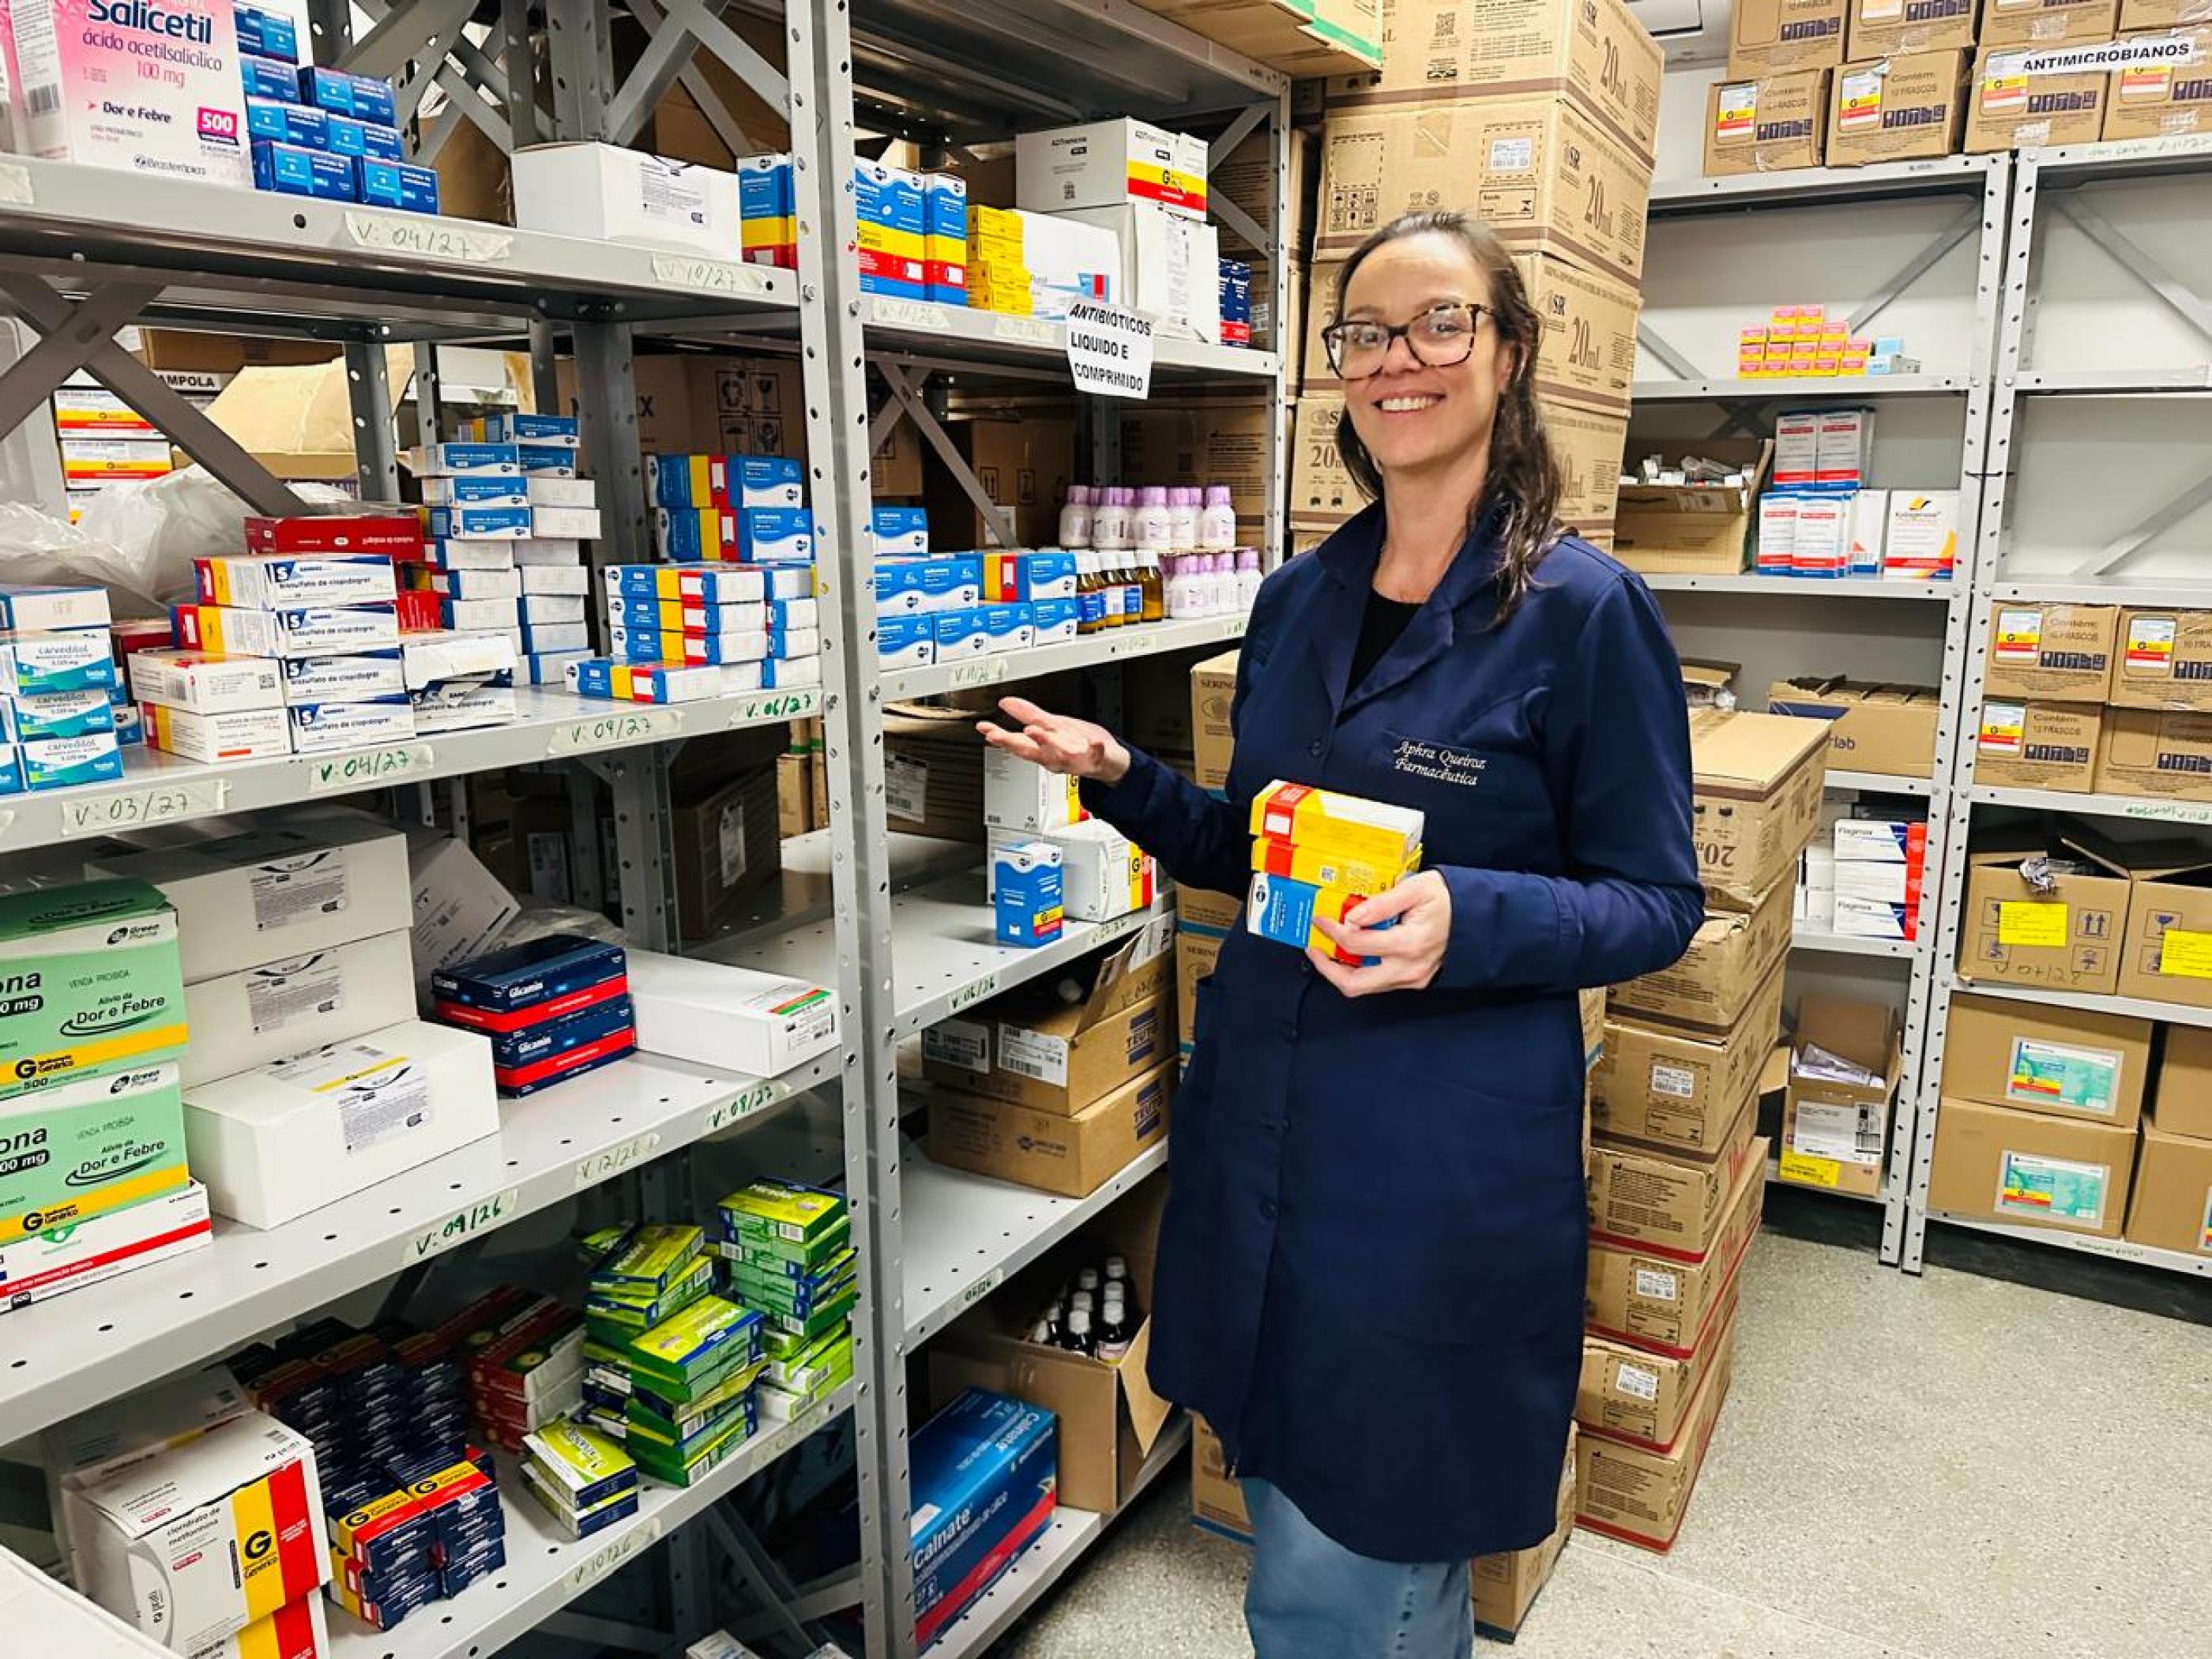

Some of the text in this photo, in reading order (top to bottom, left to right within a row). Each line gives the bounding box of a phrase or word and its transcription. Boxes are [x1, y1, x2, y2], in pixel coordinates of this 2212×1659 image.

[88, 0, 212, 44] Salicetil
[82, 28, 123, 51] ácido
[2023, 43, 2191, 71] ANTIMICROBIANOS
[137, 61, 185, 88] 100 mg
[201, 112, 234, 132] 500
[1070, 303, 1152, 337] ANTIBIÓTICOS
[1071, 332, 1129, 359] LIQUIDO E
[158, 374, 216, 388] AMPOLA
[1074, 363, 1143, 391] COMPRIMIDO
[343, 749, 410, 777] 04/27
[1439, 749, 1487, 769] Queiroz
[109, 791, 190, 824] 03/27
[13, 998, 39, 1014] mg
[77, 995, 166, 1025] Dor e Febre
[15, 1059, 37, 1078] G
[21, 1153, 46, 1168] mg
[81, 1141, 165, 1175] Dor e Febre
[22, 1212, 43, 1231] G
[441, 1195, 502, 1239] 09/26
[244, 1529, 272, 1559] G
[913, 1507, 972, 1571] Calnate
